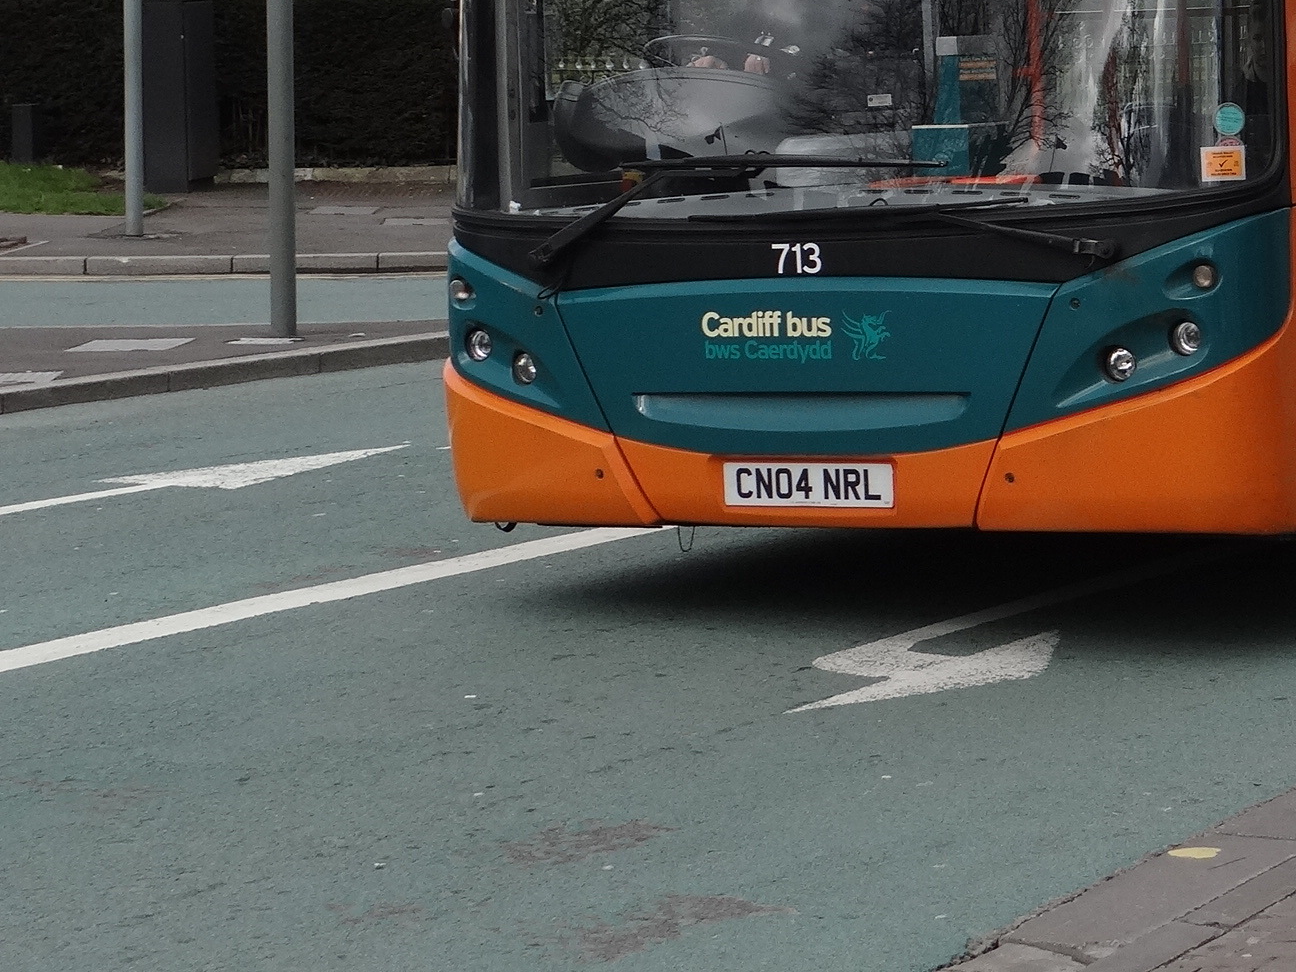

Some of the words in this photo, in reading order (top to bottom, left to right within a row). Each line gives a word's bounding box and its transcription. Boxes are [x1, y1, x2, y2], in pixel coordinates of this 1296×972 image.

[771, 242, 822, 274] 713
[701, 309, 782, 338] Cardiff
[786, 310, 832, 338] bus
[704, 339, 741, 360] bws
[744, 339, 832, 364] Caerdydd
[735, 467, 813, 500] CN04
[822, 468, 882, 501] NRL
